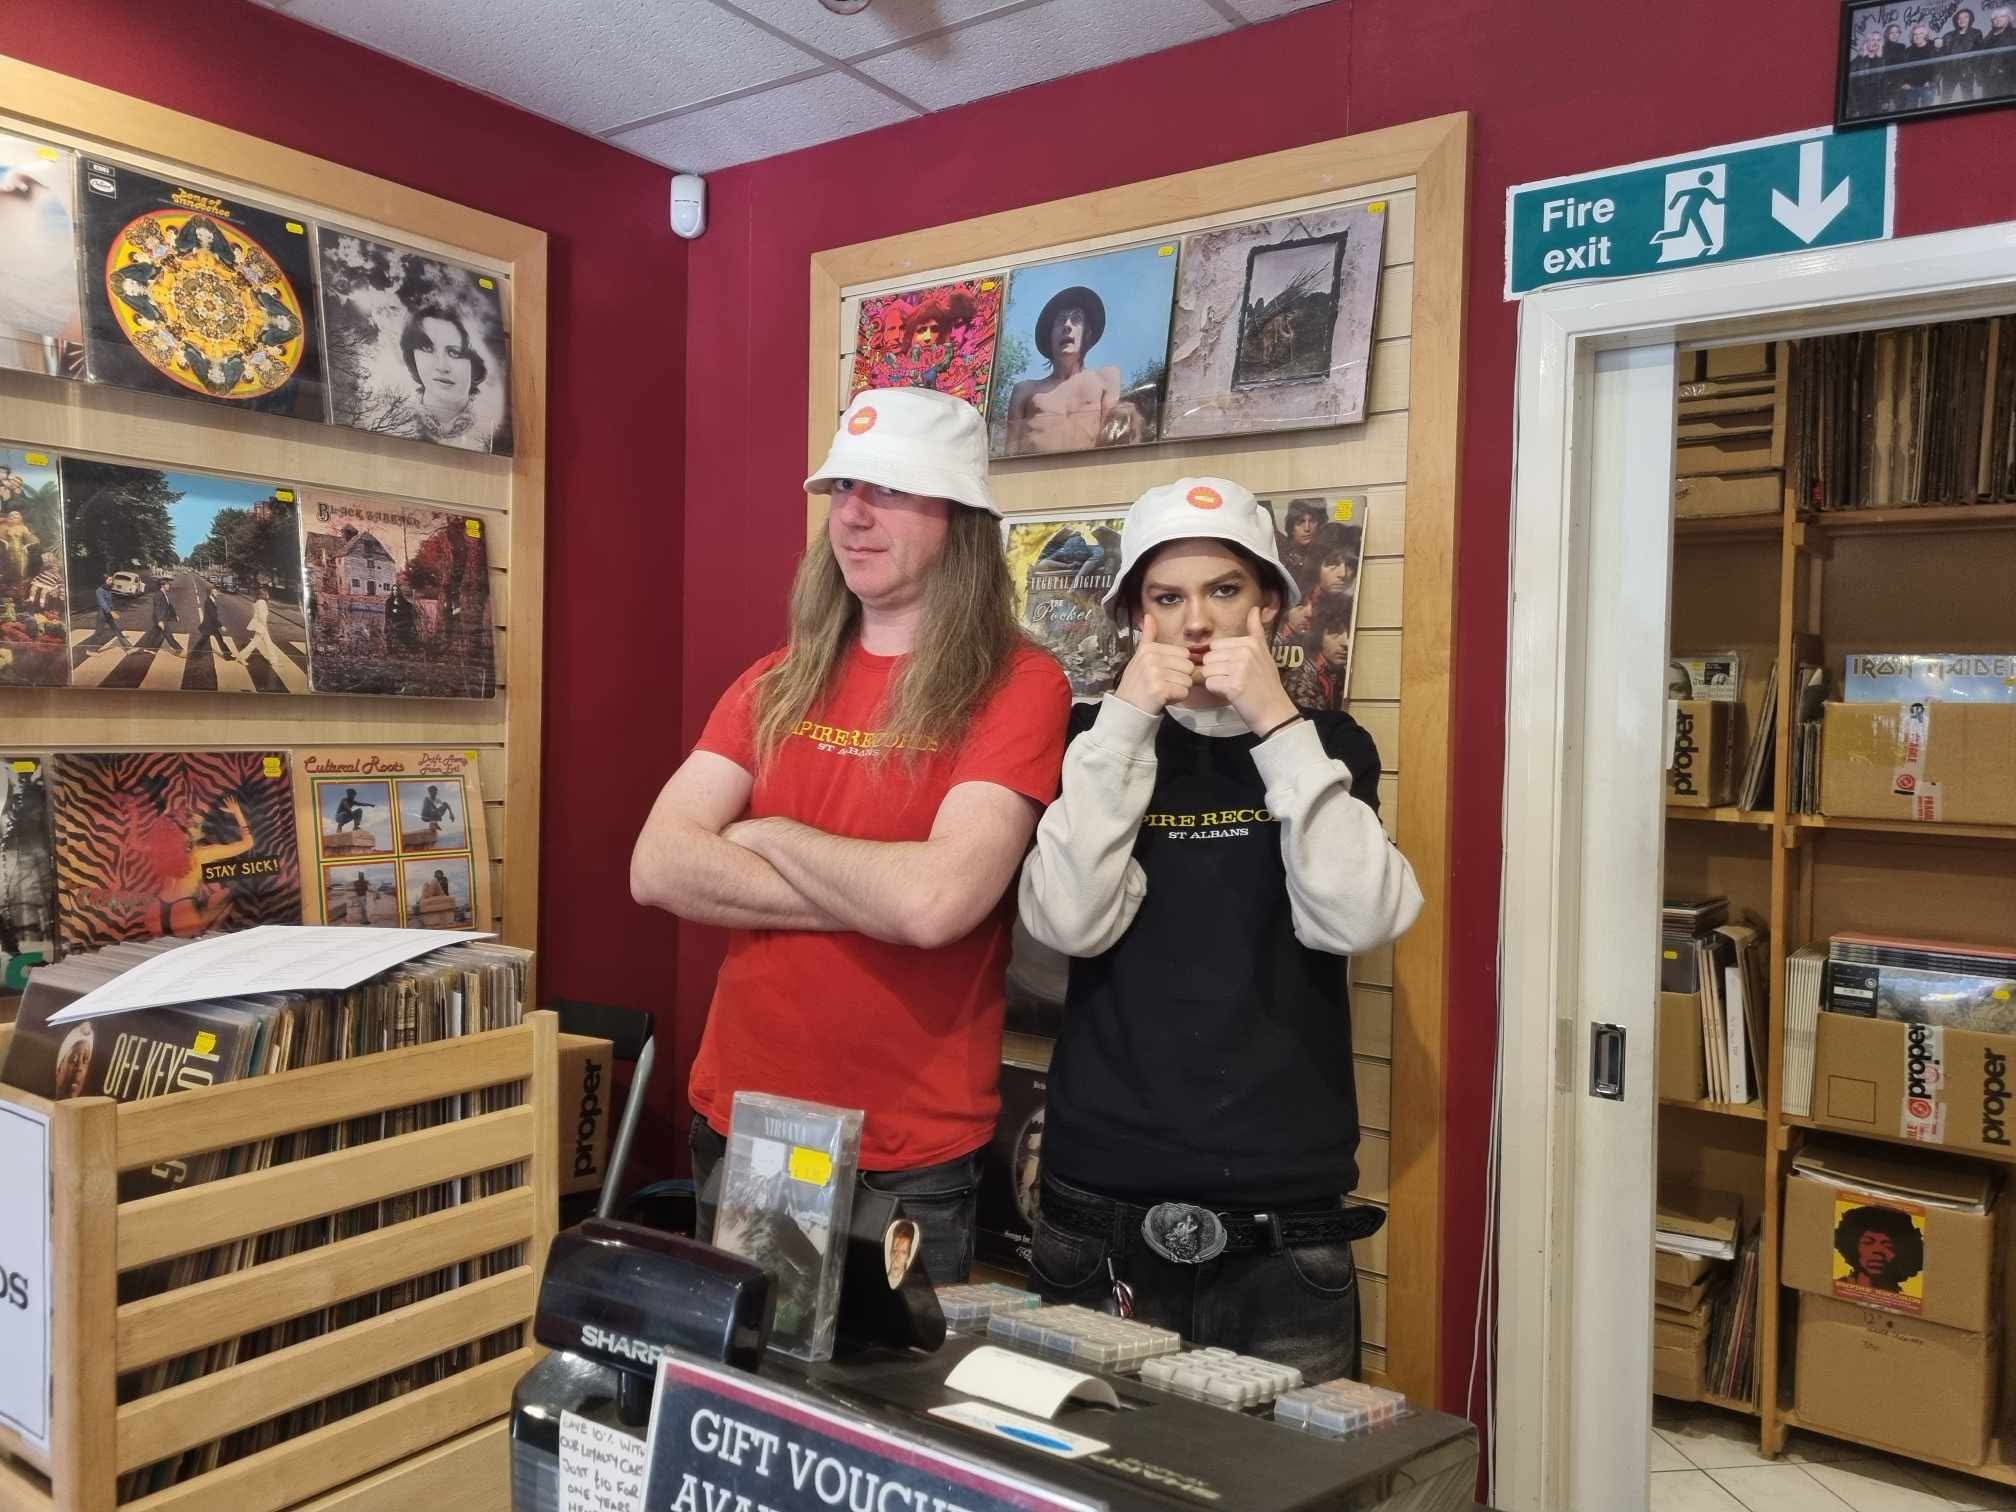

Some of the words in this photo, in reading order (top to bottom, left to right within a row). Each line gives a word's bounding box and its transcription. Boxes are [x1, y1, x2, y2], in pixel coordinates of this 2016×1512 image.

[1542, 197, 1615, 232] Fire
[1543, 236, 1611, 273] exit
[1853, 657, 1913, 680] IRON
[304, 755, 360, 774] Cultural
[361, 755, 405, 774] Roots
[816, 742, 836, 752] ST
[837, 746, 881, 757] ABANS
[1675, 708, 1699, 796] proper
[1168, 831, 1187, 840] ST
[1190, 828, 1249, 839] ALBANS
[1200, 809, 1281, 827] RECO
[206, 864, 237, 879] STAY
[241, 859, 279, 875] SICK!
[103, 1032, 149, 1099] OFF
[1908, 1025, 1932, 1099] proper
[1983, 1047, 2012, 1146] proper
[575, 1058, 602, 1177] proper
[581, 1325, 664, 1366] SHARP
[562, 1458, 588, 1477] JUST
[617, 1481, 640, 1498] FOR
[690, 1408, 780, 1476] GIFT
[788, 1442, 974, 1512] VOUC
[568, 1484, 590, 1500] ONE
